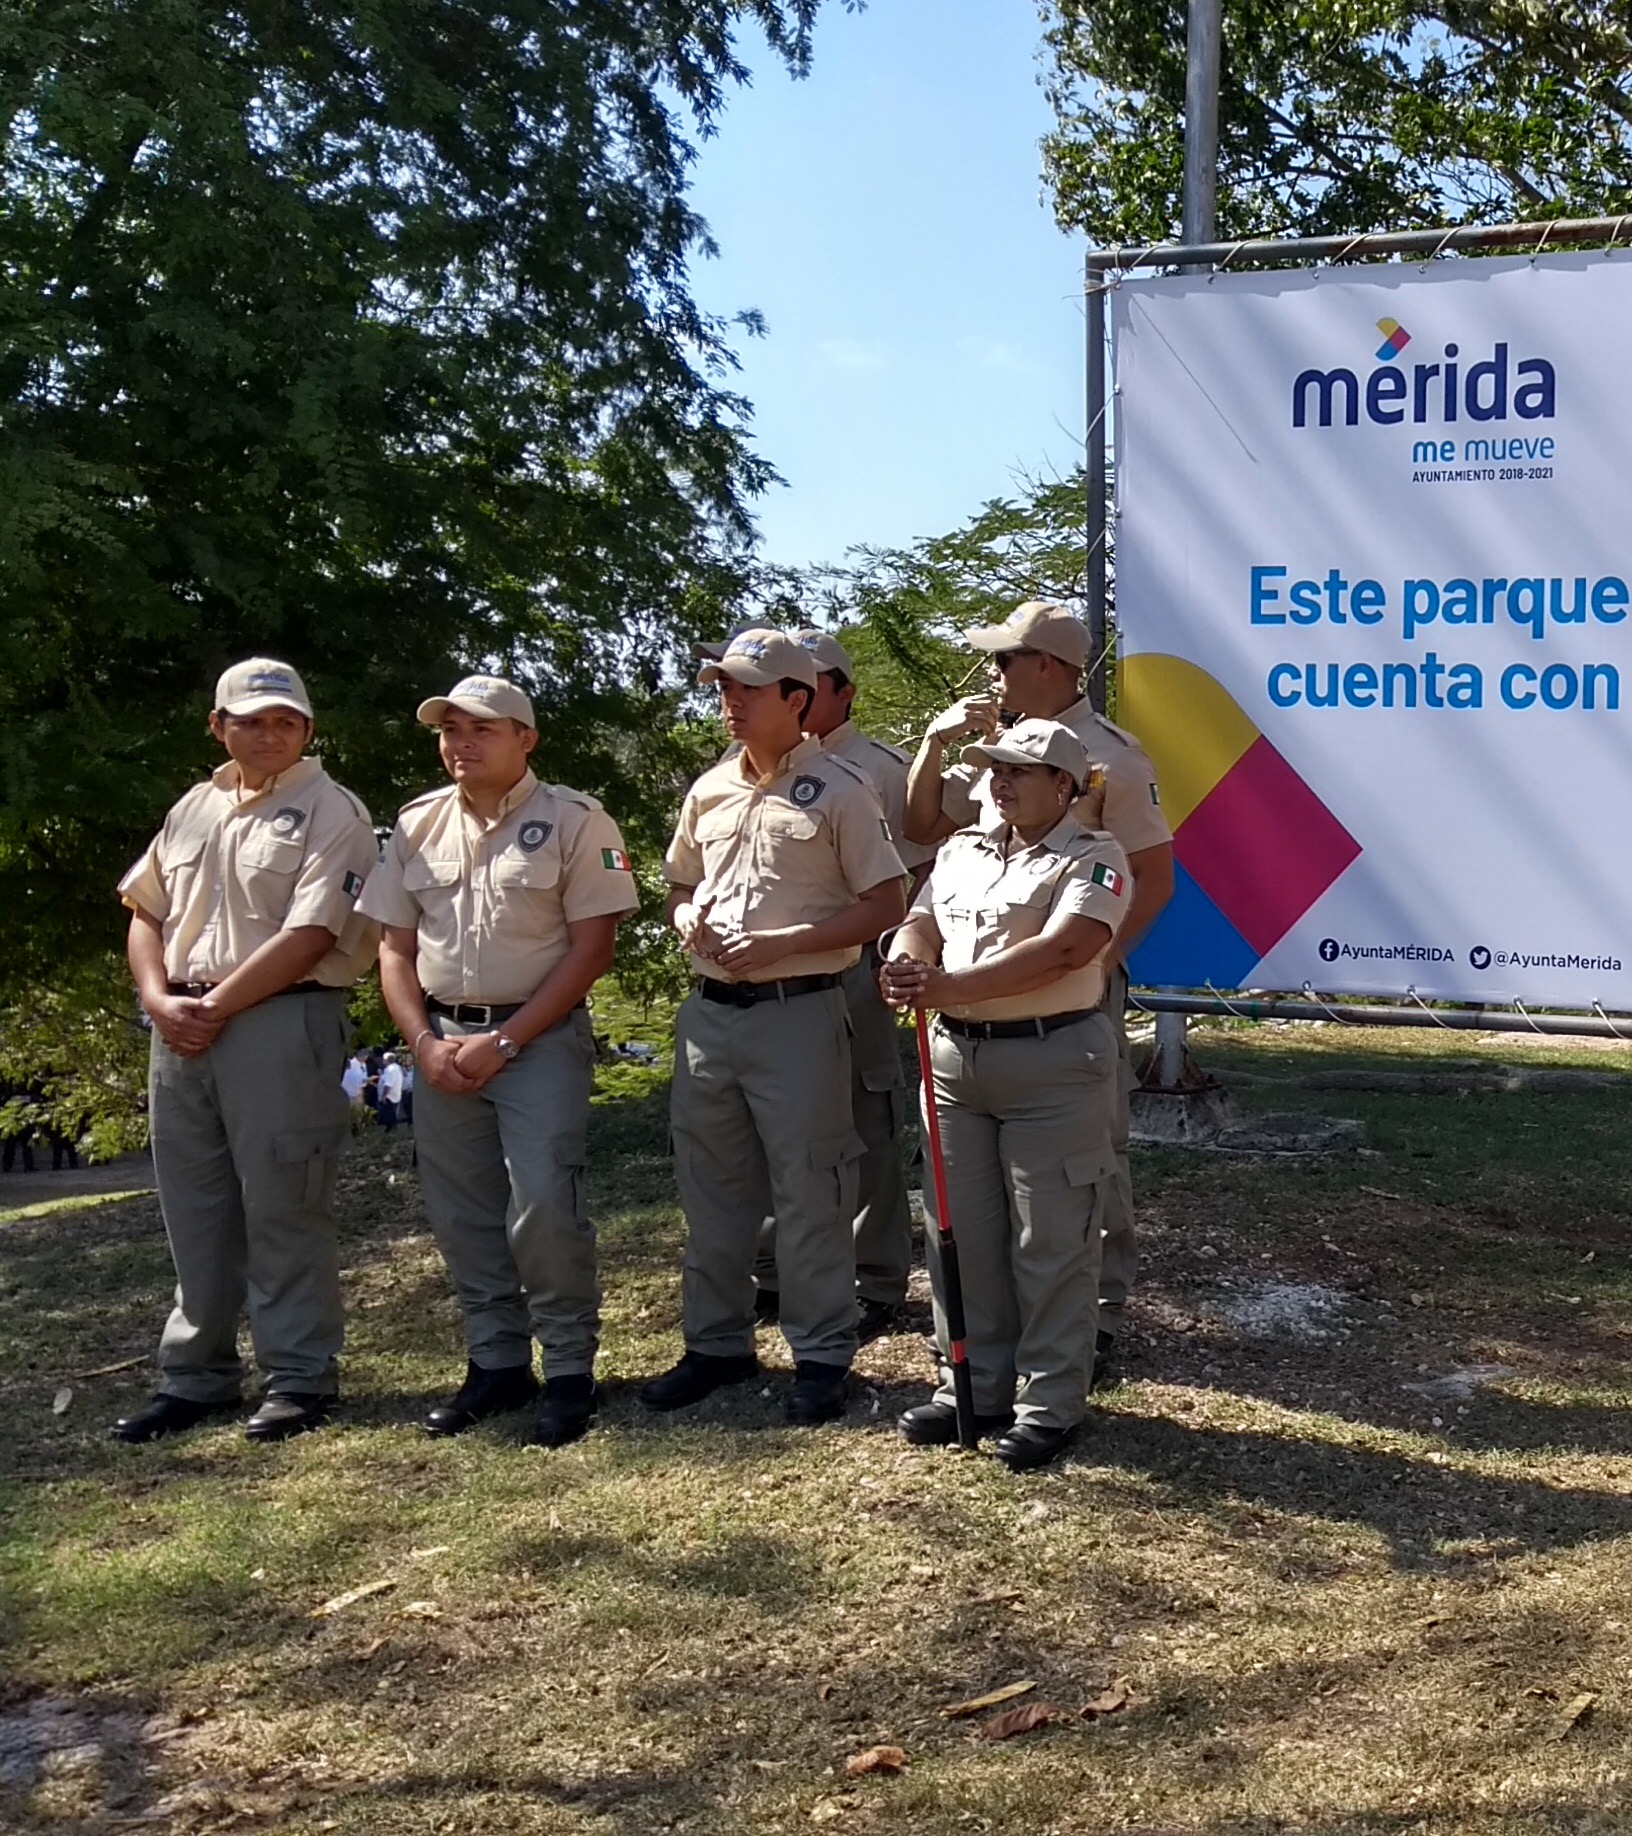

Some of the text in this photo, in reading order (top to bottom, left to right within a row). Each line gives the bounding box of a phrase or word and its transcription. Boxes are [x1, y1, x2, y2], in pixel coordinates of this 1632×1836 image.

[1292, 317, 1556, 428] mérida
[1412, 436, 1555, 463] me mueve
[1412, 467, 1554, 483] AYUNTAMIENTO 2018-2021
[1250, 565, 1630, 640] Este parque
[1267, 652, 1620, 710] cuenta con
[1340, 943, 1455, 963] AyuntaMÉRIDA
[1494, 950, 1622, 971] @AyuntaMerida
